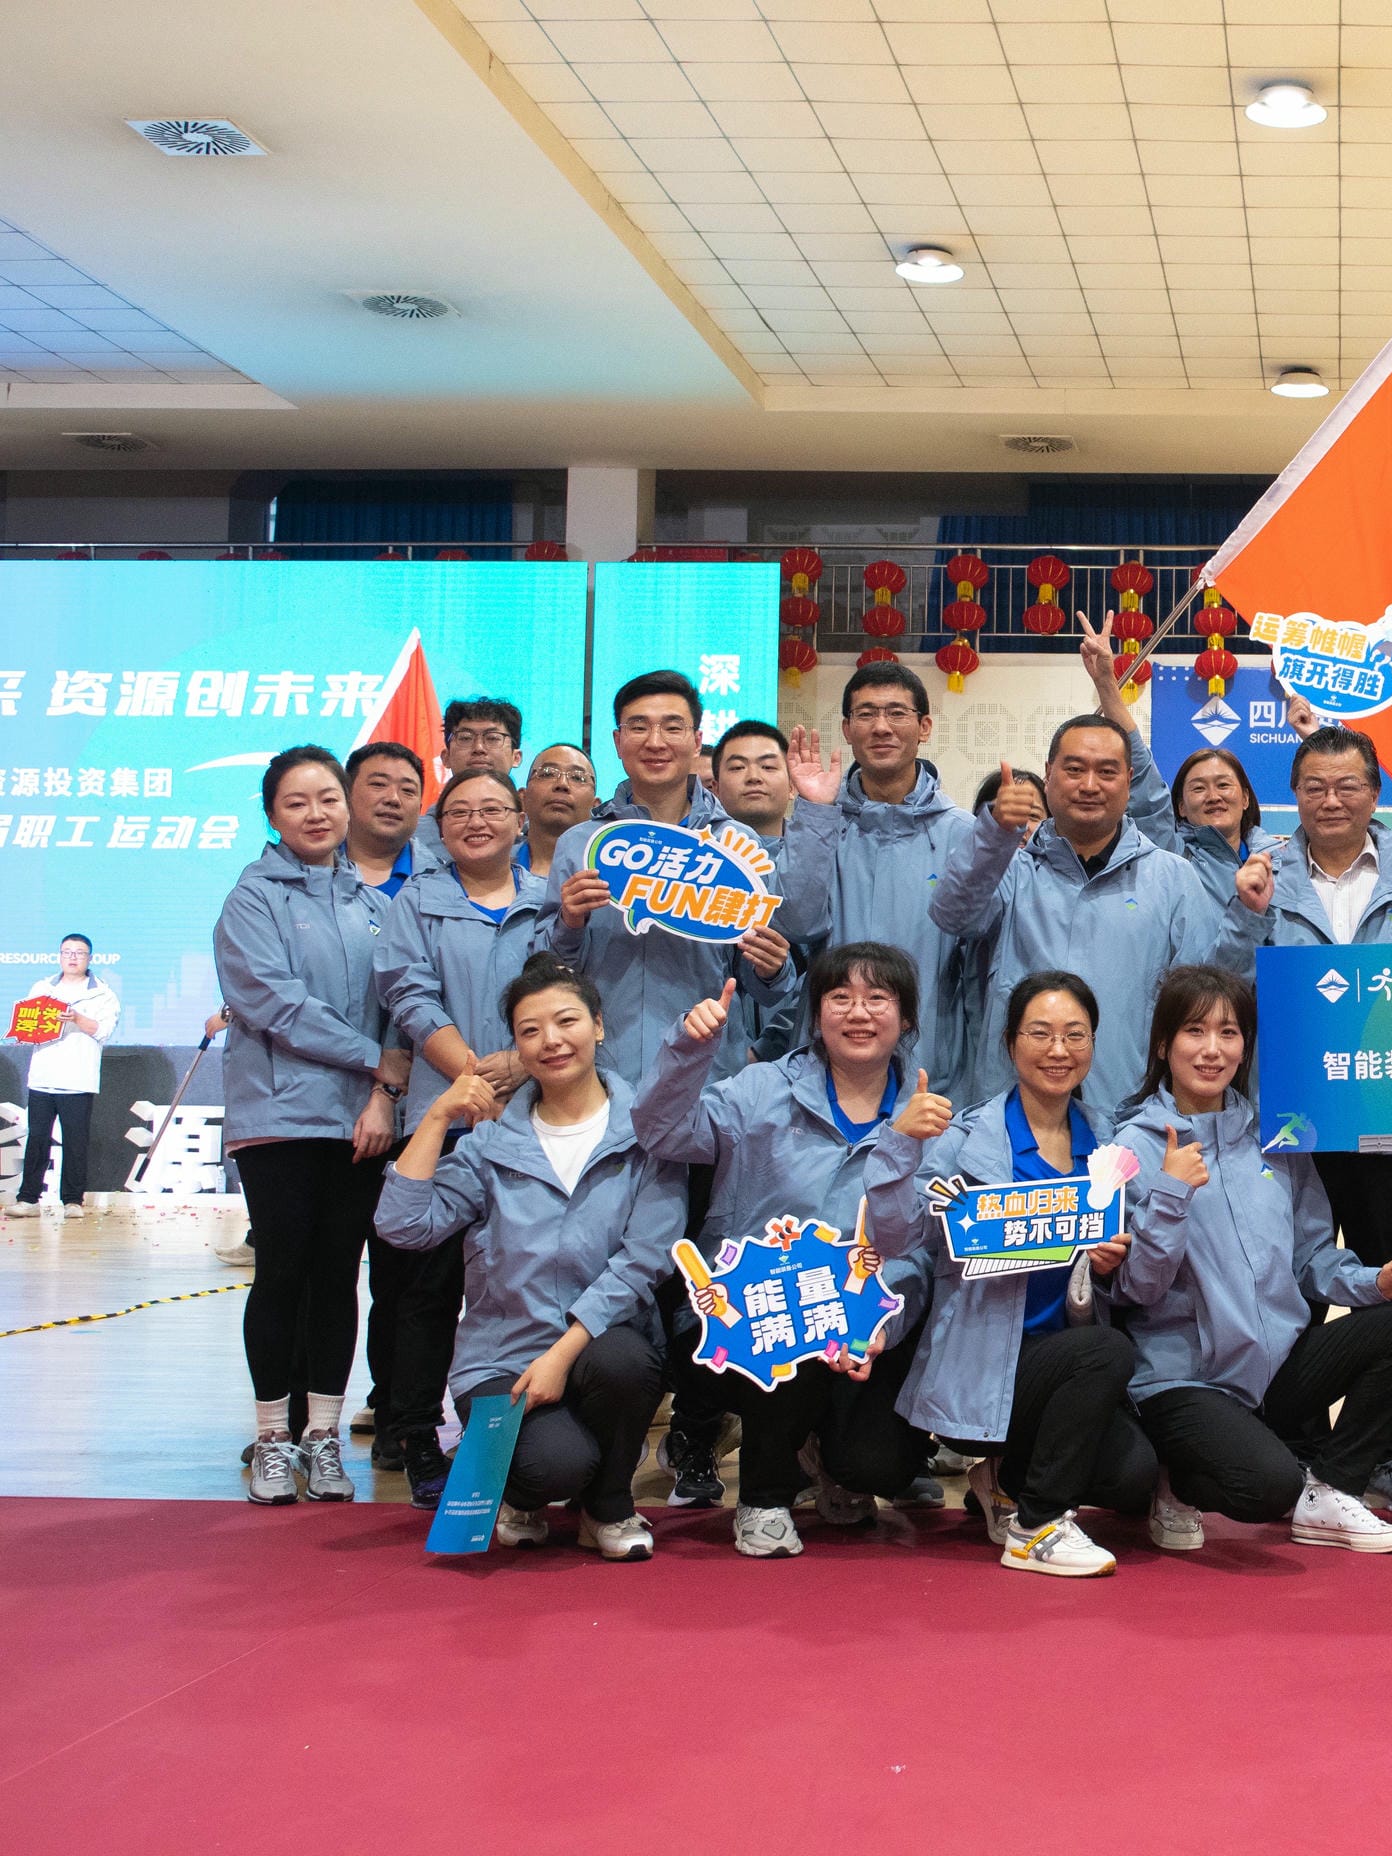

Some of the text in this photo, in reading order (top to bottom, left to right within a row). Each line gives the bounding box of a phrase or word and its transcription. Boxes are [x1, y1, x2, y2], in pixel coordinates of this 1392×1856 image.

[1251, 614, 1368, 660] 运筹帷幄
[46, 670, 385, 717] 资源创未来
[1278, 656, 1383, 699] 旗开得胜
[0, 767, 173, 798] 源投资集团
[0, 814, 240, 849] 职工运动会
[600, 839, 724, 884] GO活力
[621, 876, 782, 929] FUN肆打
[0, 952, 120, 965] RESOURC OUP
[976, 1186, 1079, 1221] 热血归来
[1004, 1212, 1105, 1248] 势不可挡
[743, 1265, 841, 1319] 能量
[751, 1301, 849, 1356] 满满
